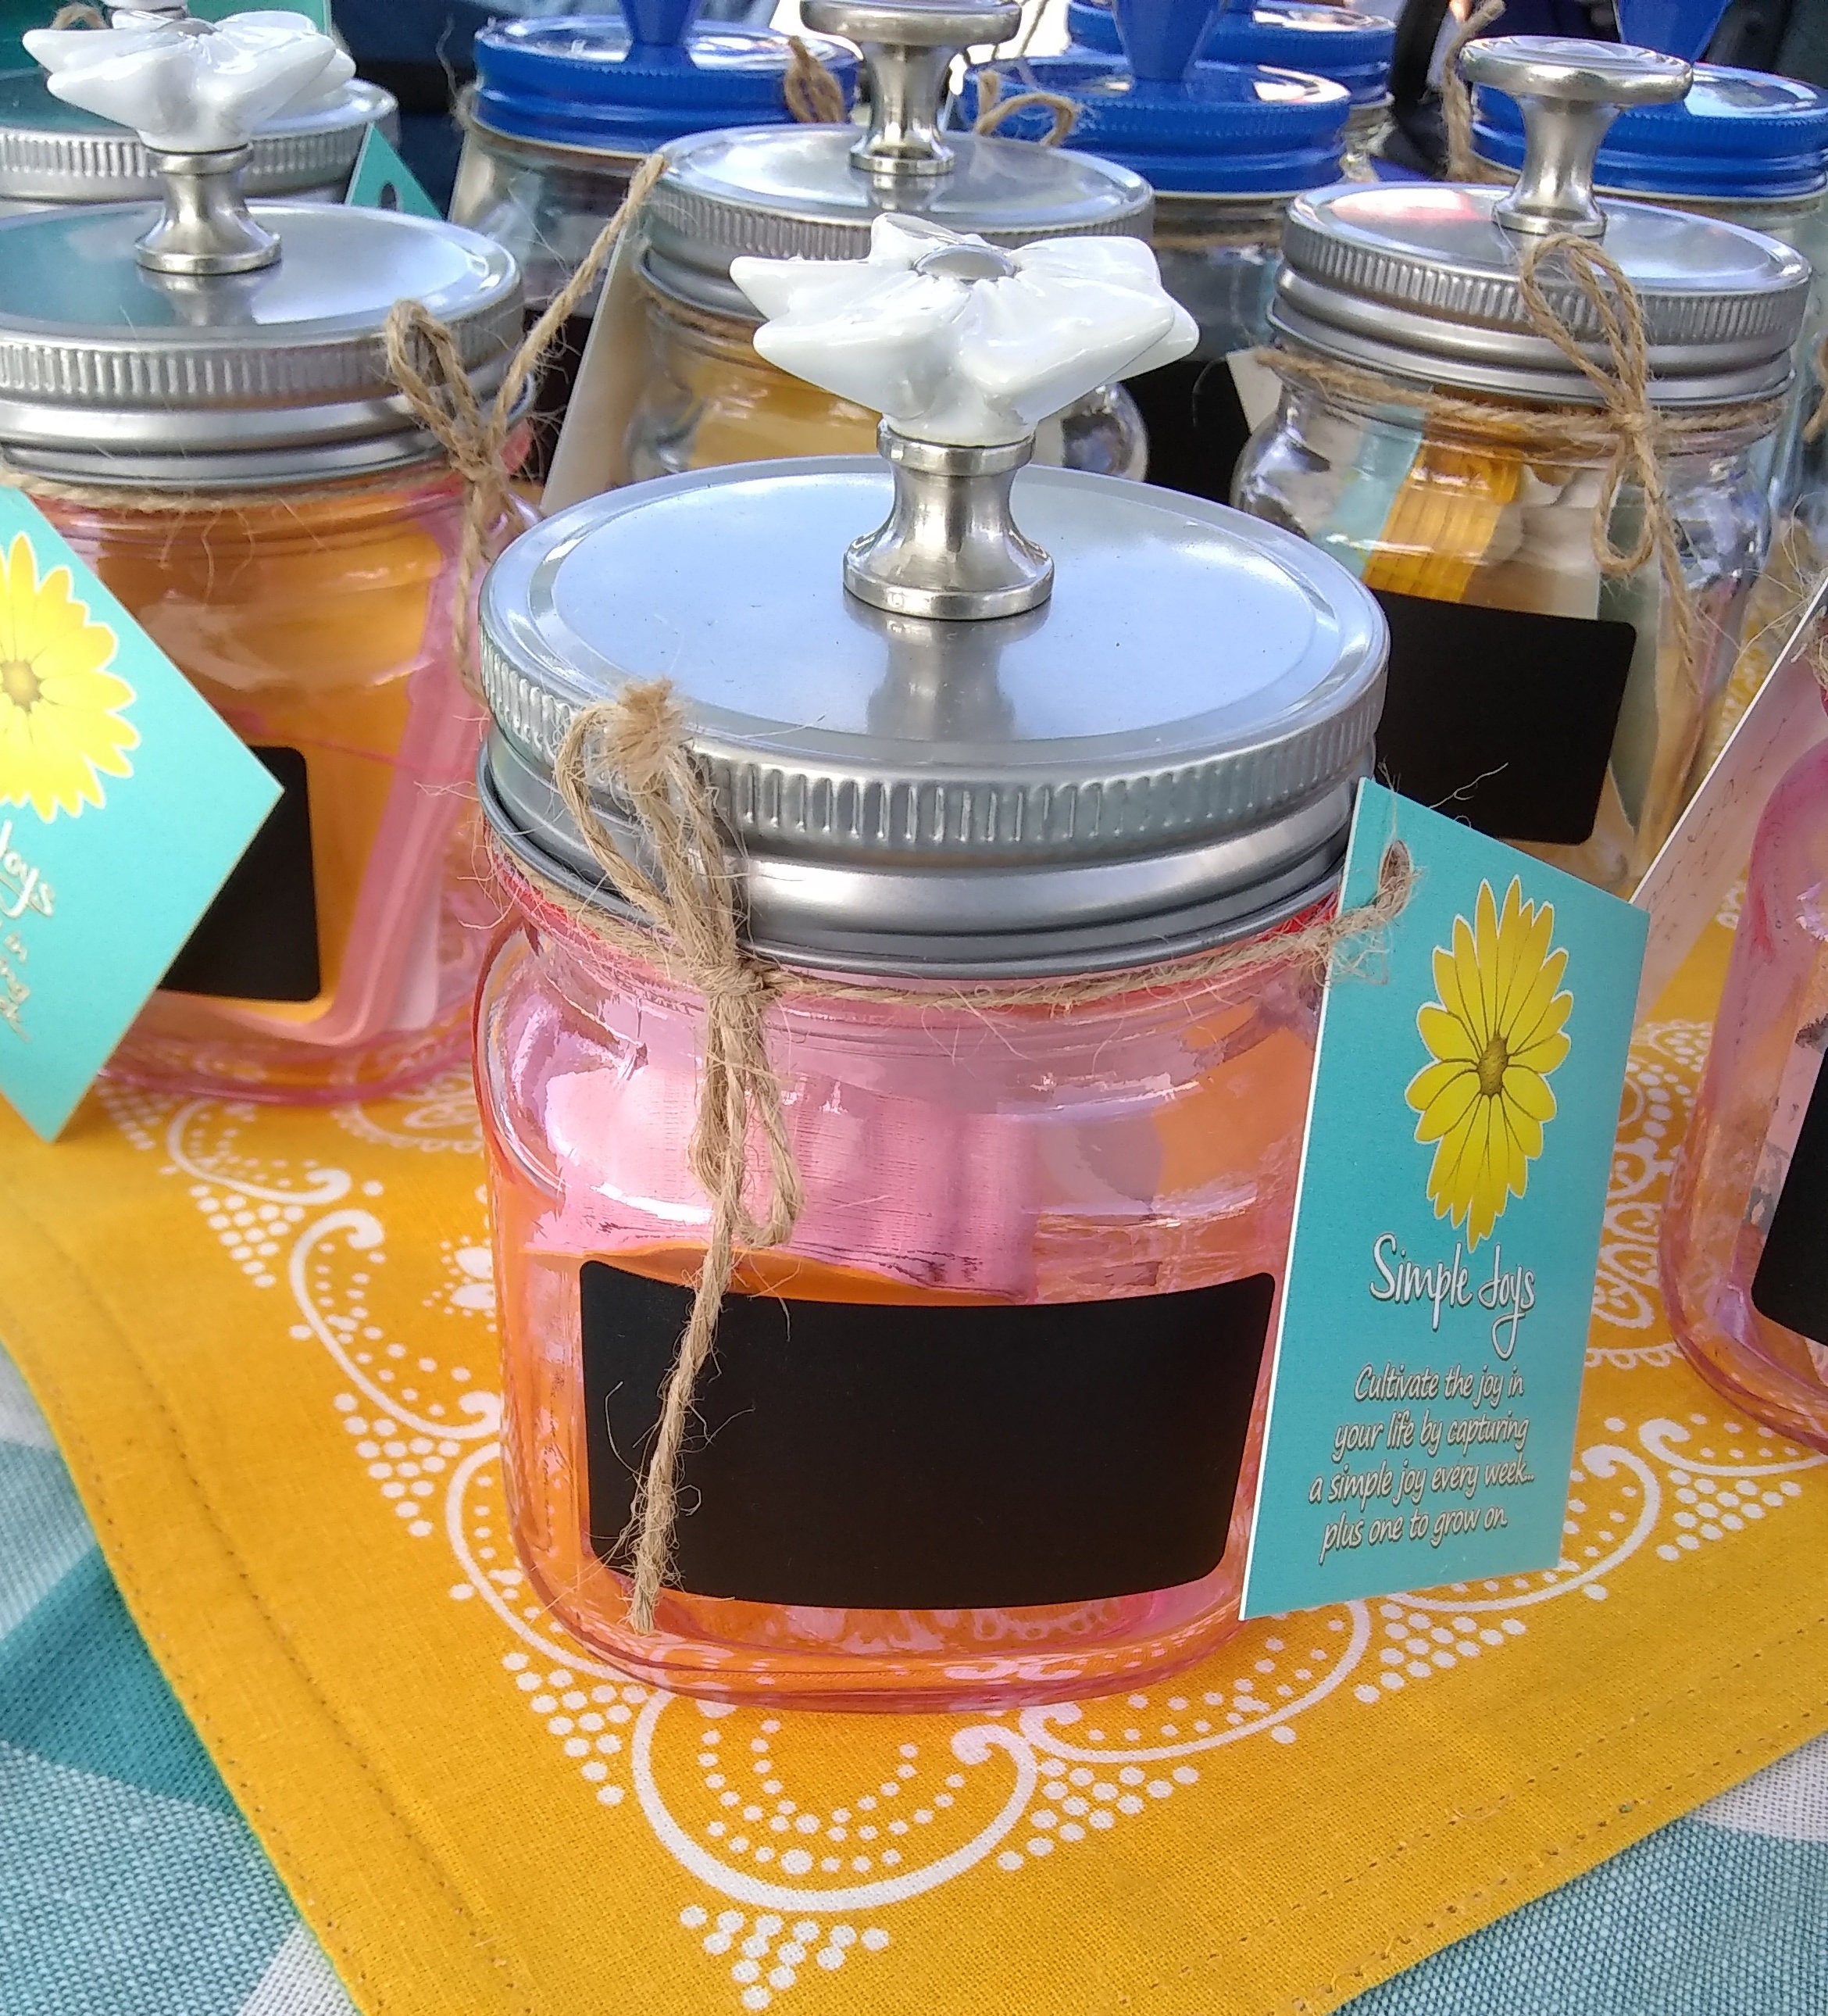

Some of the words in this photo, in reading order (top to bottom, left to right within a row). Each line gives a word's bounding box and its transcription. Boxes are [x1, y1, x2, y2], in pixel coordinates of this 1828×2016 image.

[1370, 1233, 1473, 1331] Simple
[1478, 1244, 1535, 1358] Joys
[1354, 1363, 1438, 1401] Cultivate
[1444, 1364, 1473, 1397] the
[1473, 1364, 1503, 1407] joy
[1508, 1364, 1523, 1397] in
[1332, 1421, 1383, 1461] your
[1386, 1410, 1414, 1449] life
[1420, 1409, 1443, 1455] by
[1447, 1410, 1530, 1455] capturing
[1309, 1474, 1322, 1506] a
[1328, 1460, 1391, 1510] simple
[1393, 1459, 1427, 1505] joy
[1431, 1462, 1479, 1499] every
[1319, 1511, 1363, 1566] plus
[1369, 1517, 1403, 1543] one
[1410, 1508, 1429, 1539] to
[1430, 1508, 1480, 1547] grow
